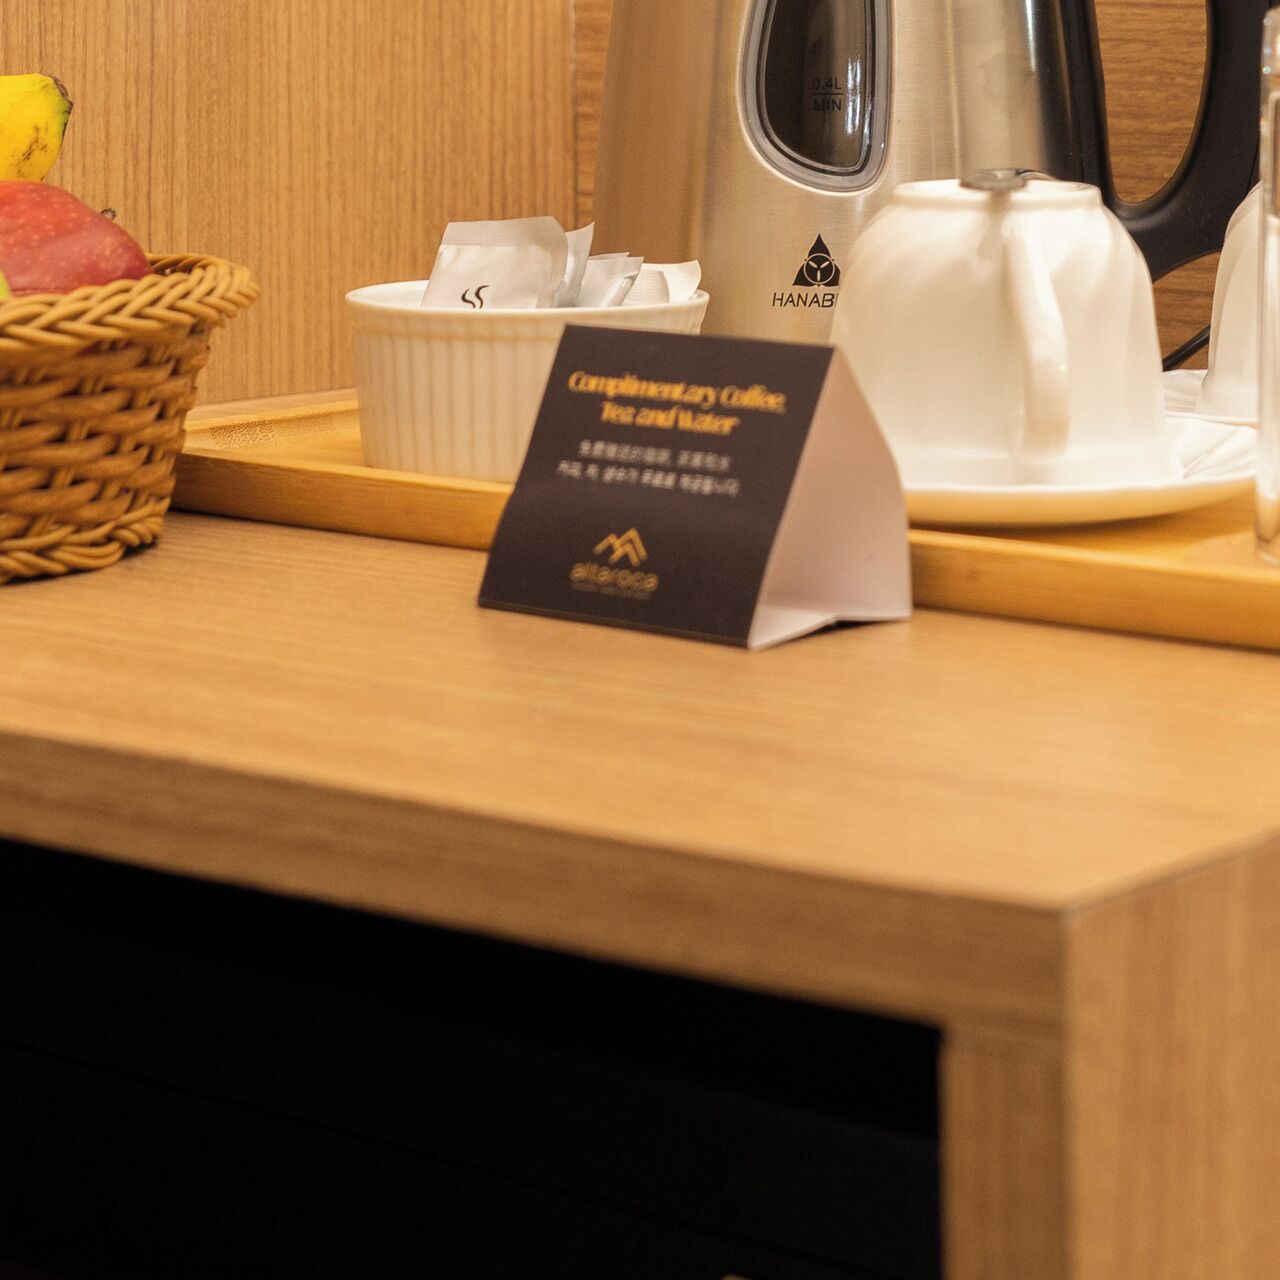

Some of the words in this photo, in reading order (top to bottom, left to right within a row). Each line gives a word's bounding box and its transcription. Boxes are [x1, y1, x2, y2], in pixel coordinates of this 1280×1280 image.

[568, 370, 717, 410] Complimentary
[600, 400, 637, 425] Tea
[635, 406, 677, 430] and
[676, 408, 741, 436] Water
